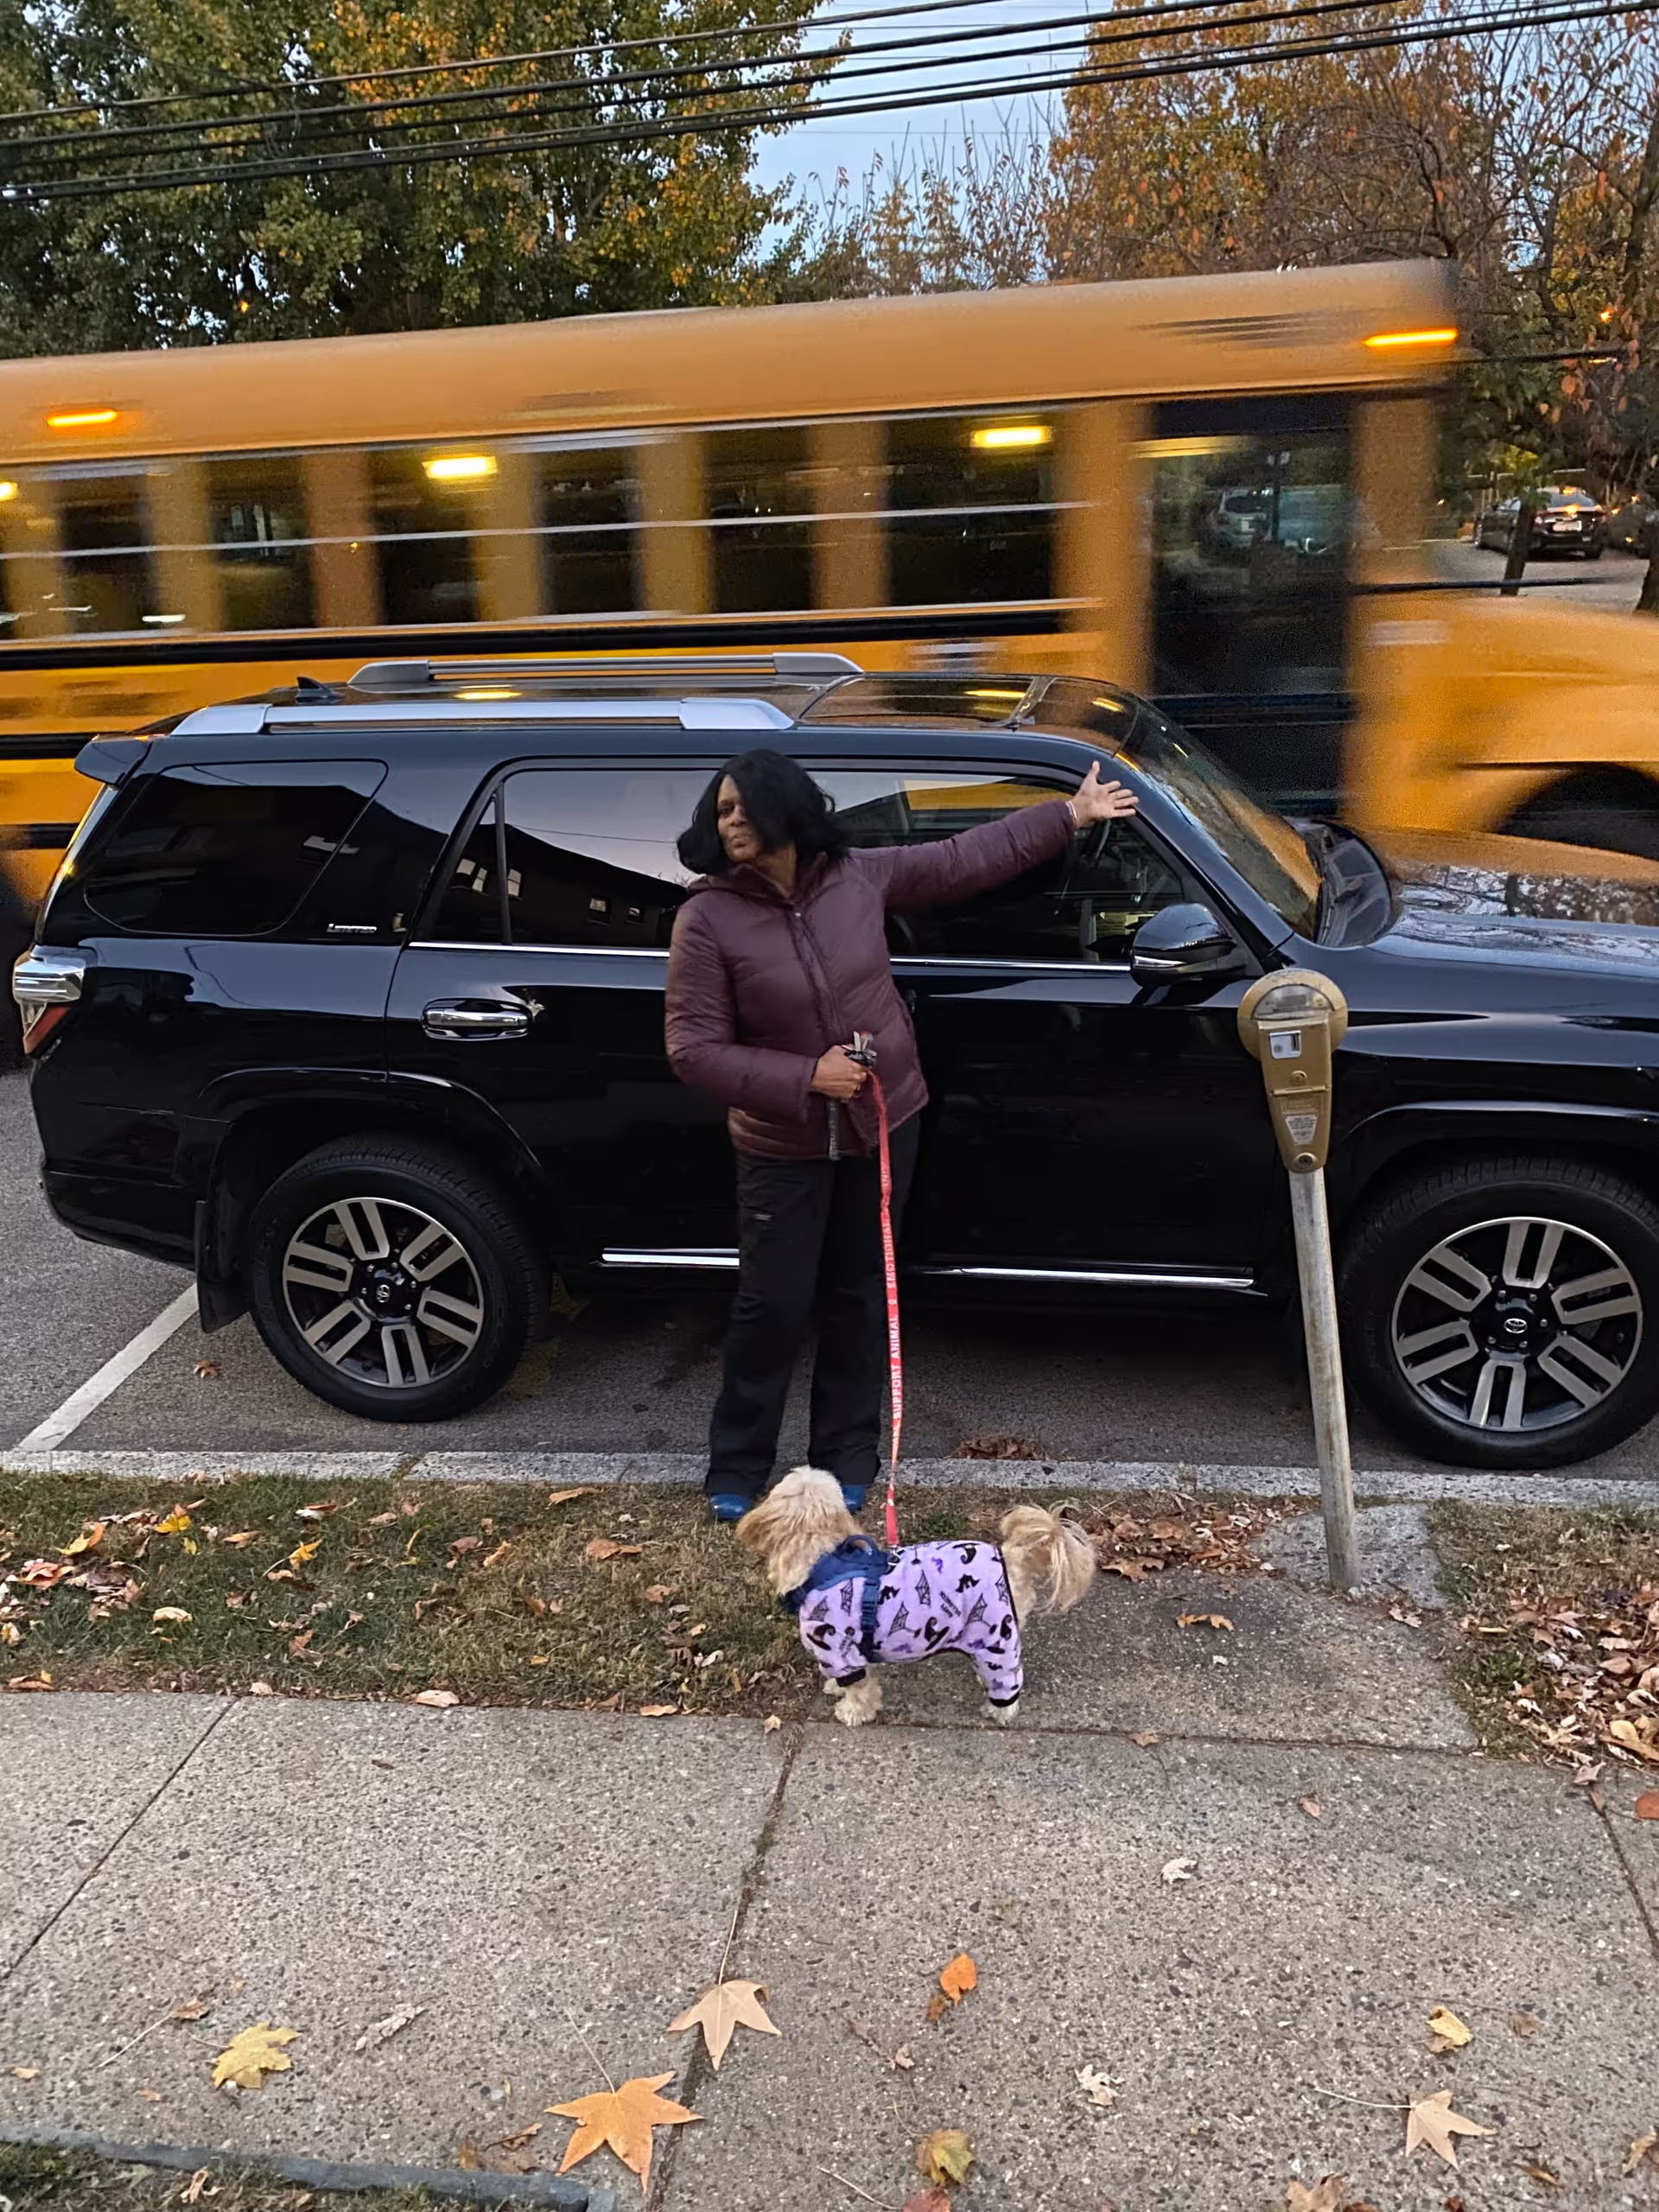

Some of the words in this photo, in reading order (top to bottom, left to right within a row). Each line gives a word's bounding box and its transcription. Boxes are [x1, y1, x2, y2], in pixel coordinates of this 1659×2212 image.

[881, 1223, 896, 1288] EMOTIONAL
[889, 1314, 900, 1359] ANIMAL
[891, 1364, 902, 1420] SUPPORT
